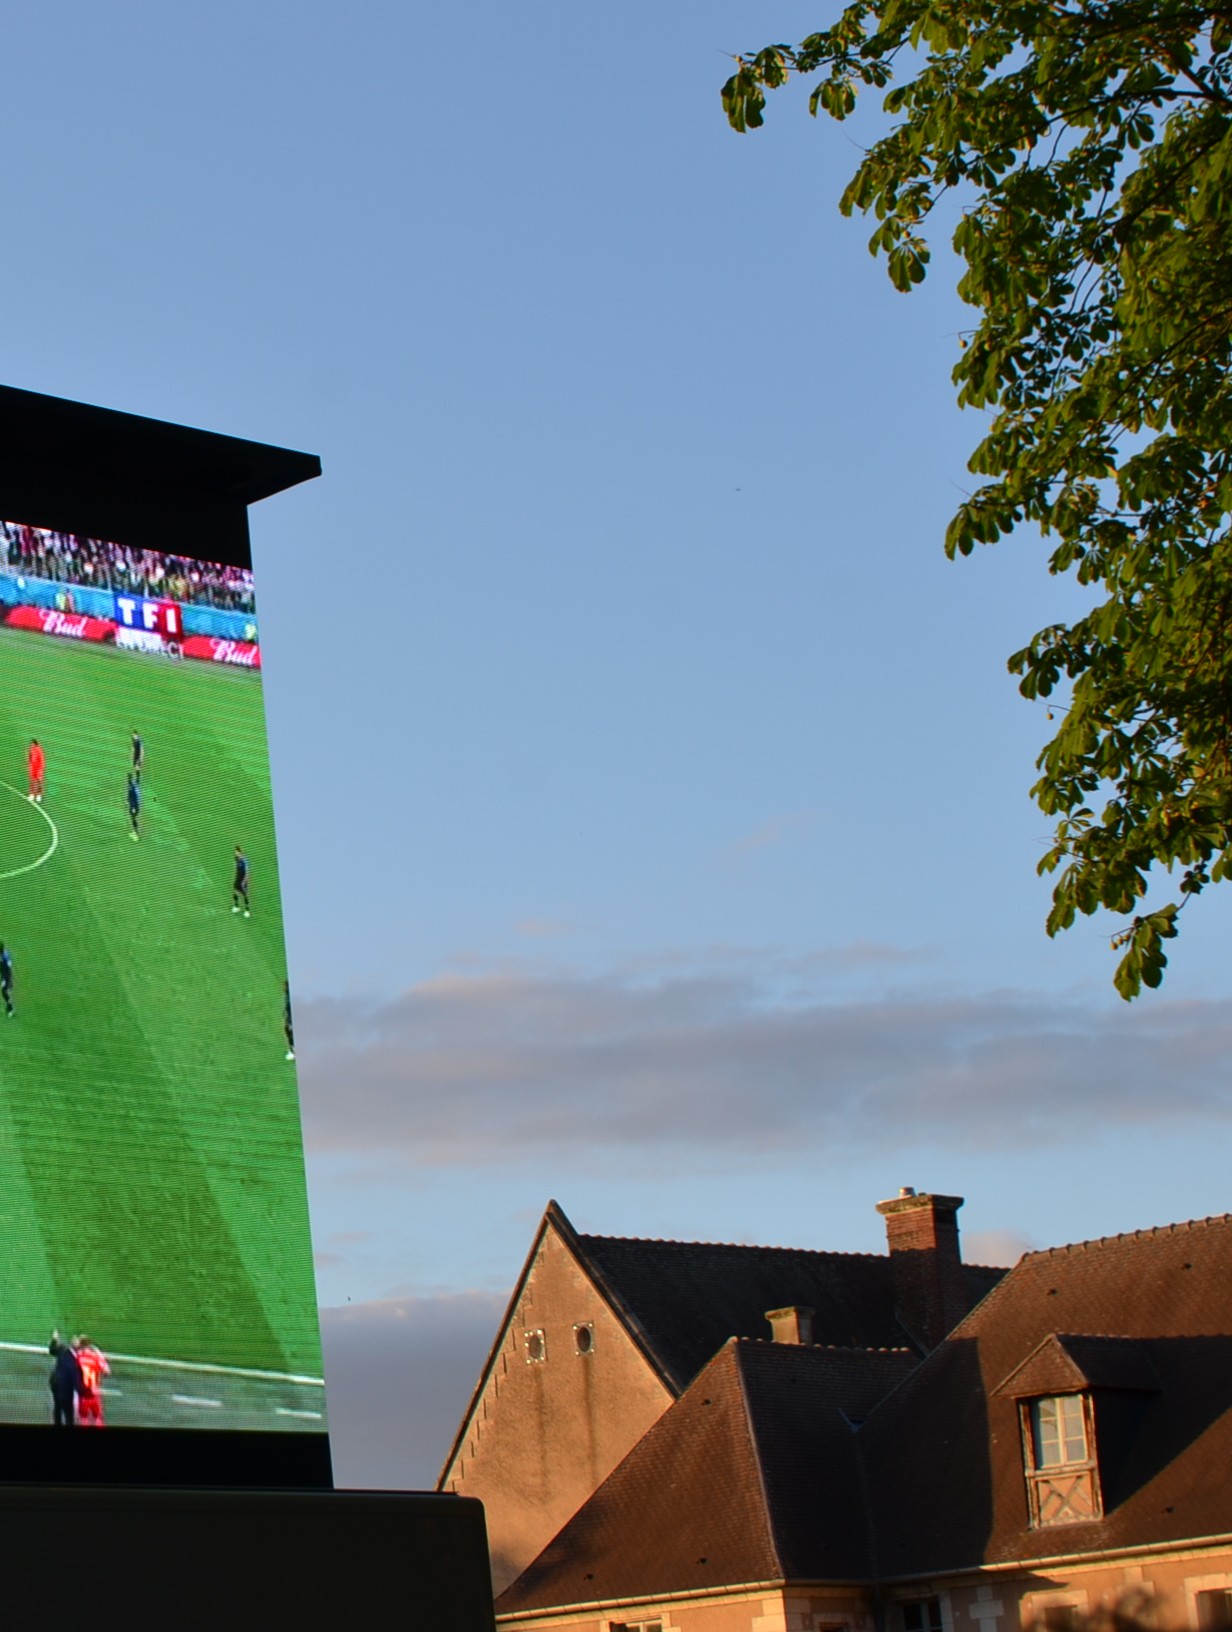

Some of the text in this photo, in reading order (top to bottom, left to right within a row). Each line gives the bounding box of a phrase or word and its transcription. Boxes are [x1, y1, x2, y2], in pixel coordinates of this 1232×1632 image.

[38, 608, 88, 637] Bud
[117, 597, 177, 633] TF1
[209, 637, 258, 666] Bud
